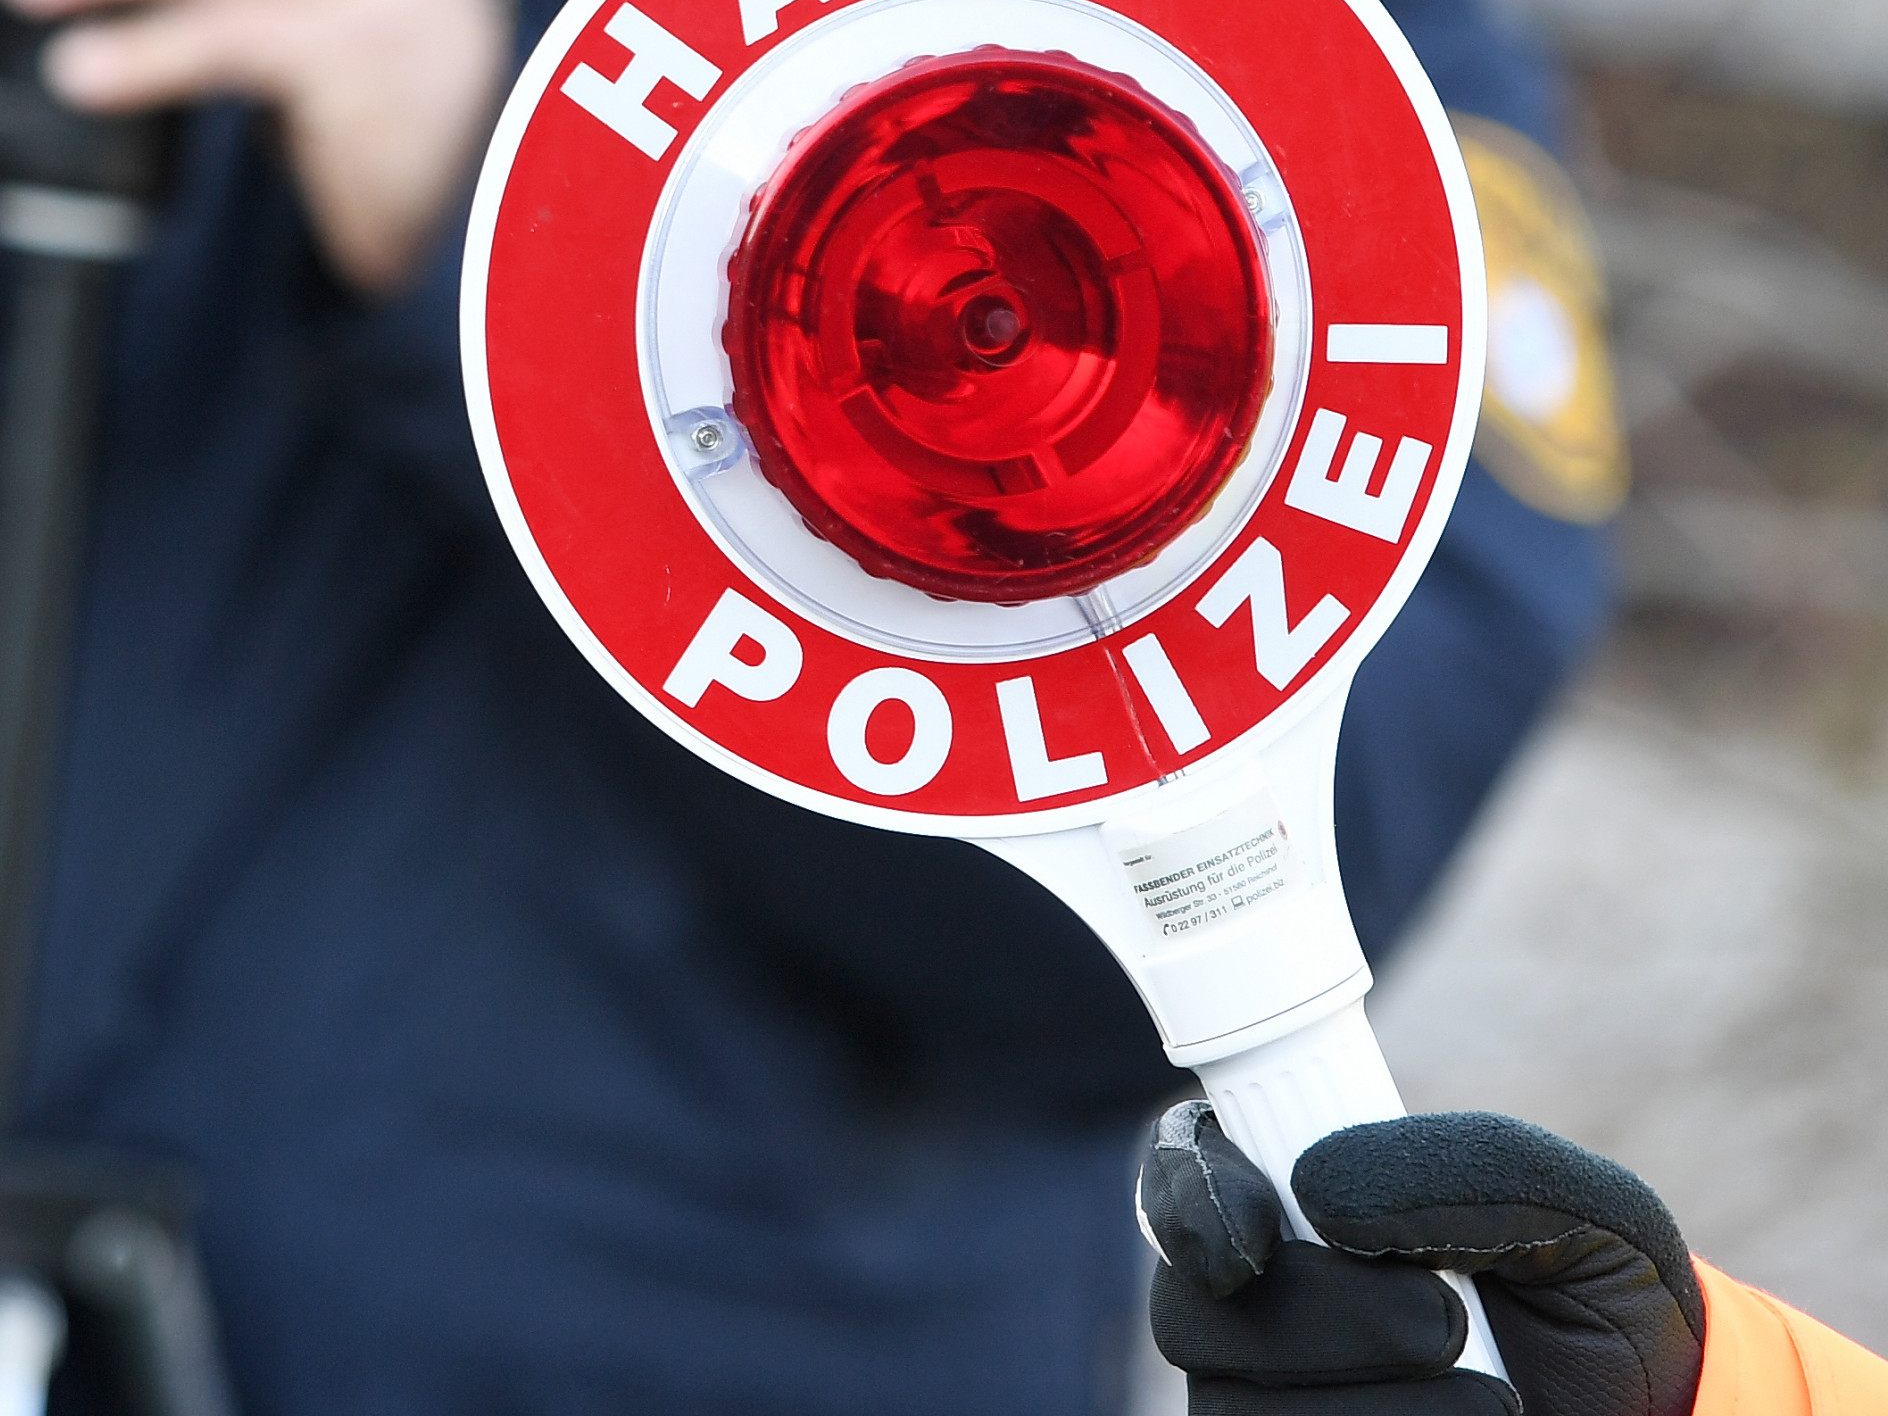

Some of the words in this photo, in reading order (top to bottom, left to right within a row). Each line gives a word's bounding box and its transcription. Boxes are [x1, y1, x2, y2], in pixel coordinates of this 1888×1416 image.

[662, 323, 1448, 802] POLIZEI
[1134, 867, 1195, 893] FASSBENDER
[1196, 828, 1274, 872] EINSATZTECHNIK
[1145, 881, 1206, 908] Ausrüstung
[1208, 872, 1223, 885] für
[1227, 864, 1245, 876] die
[1247, 843, 1278, 867] Polizei
[1191, 915, 1202, 927] 97
[1211, 906, 1228, 919] 311
